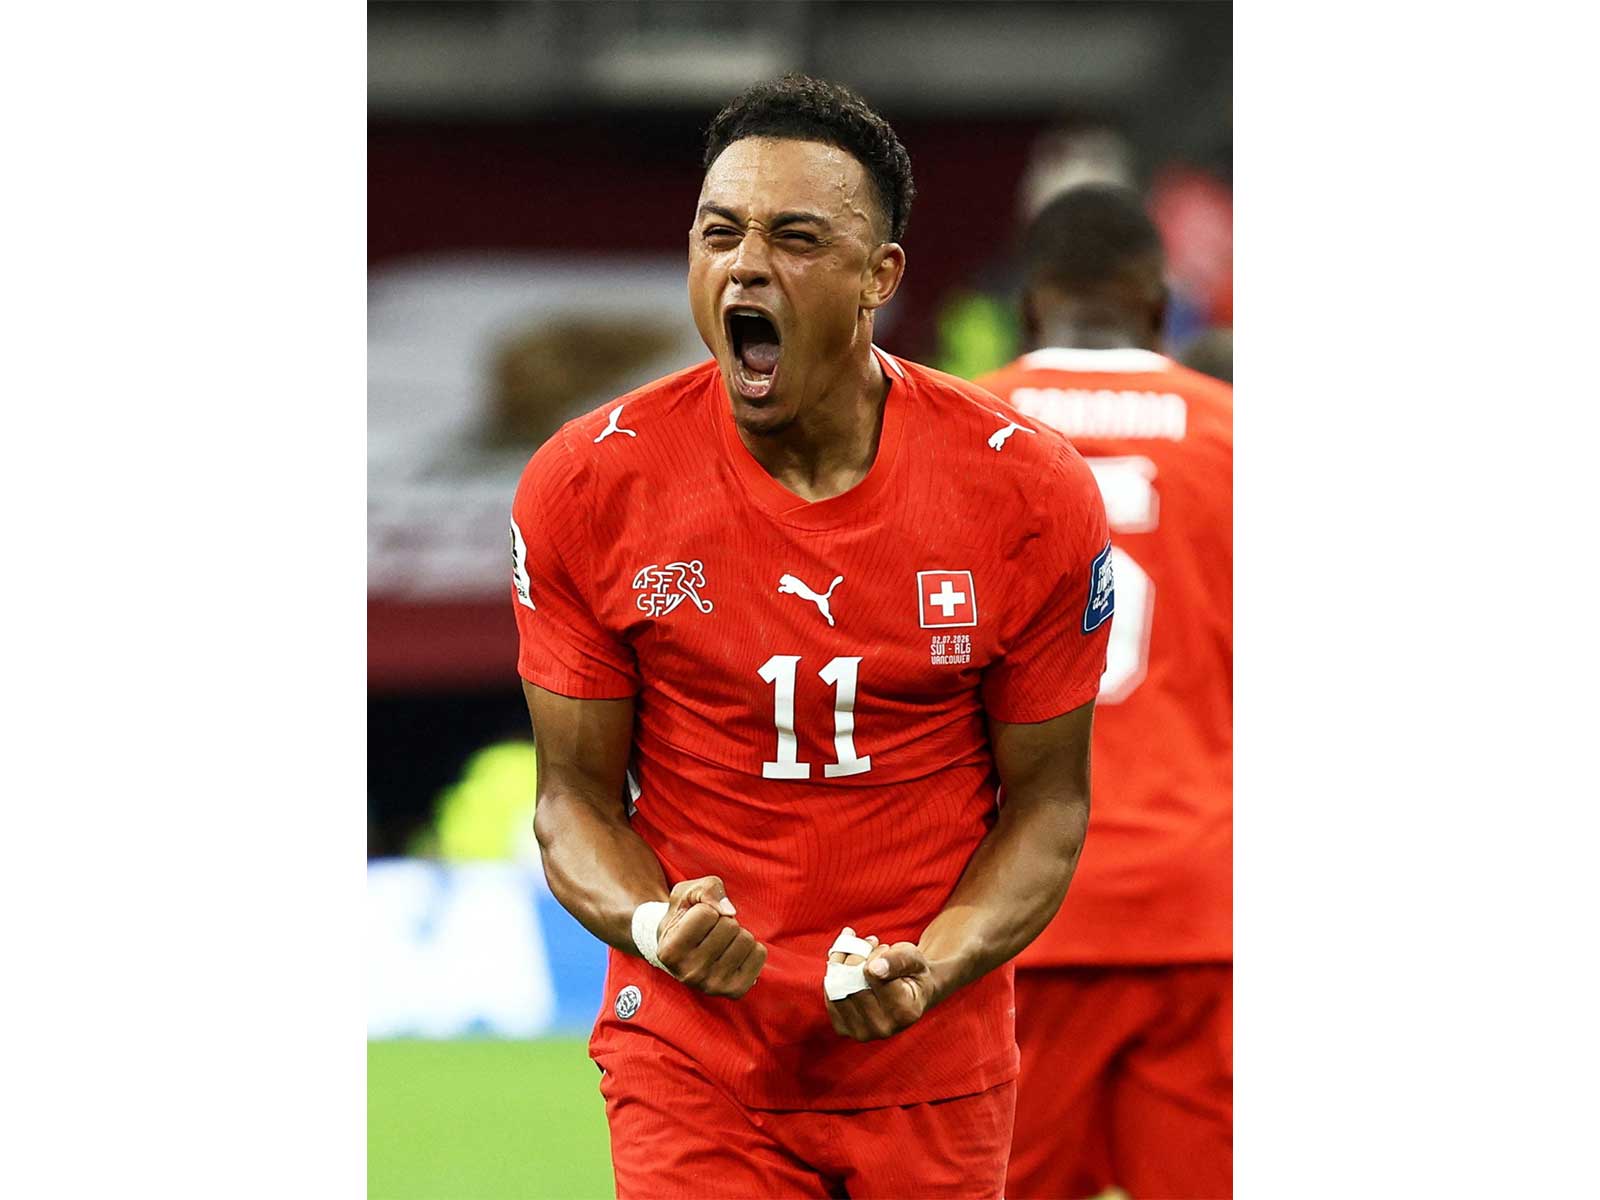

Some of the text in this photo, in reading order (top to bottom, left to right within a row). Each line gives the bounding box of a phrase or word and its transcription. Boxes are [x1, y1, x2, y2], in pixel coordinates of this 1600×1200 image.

[932, 634, 970, 644] 02.07.2026
[930, 644, 945, 655] SUI
[954, 643, 971, 655] ALG
[931, 655, 970, 665] VANCOUVER
[757, 655, 872, 779] 11
